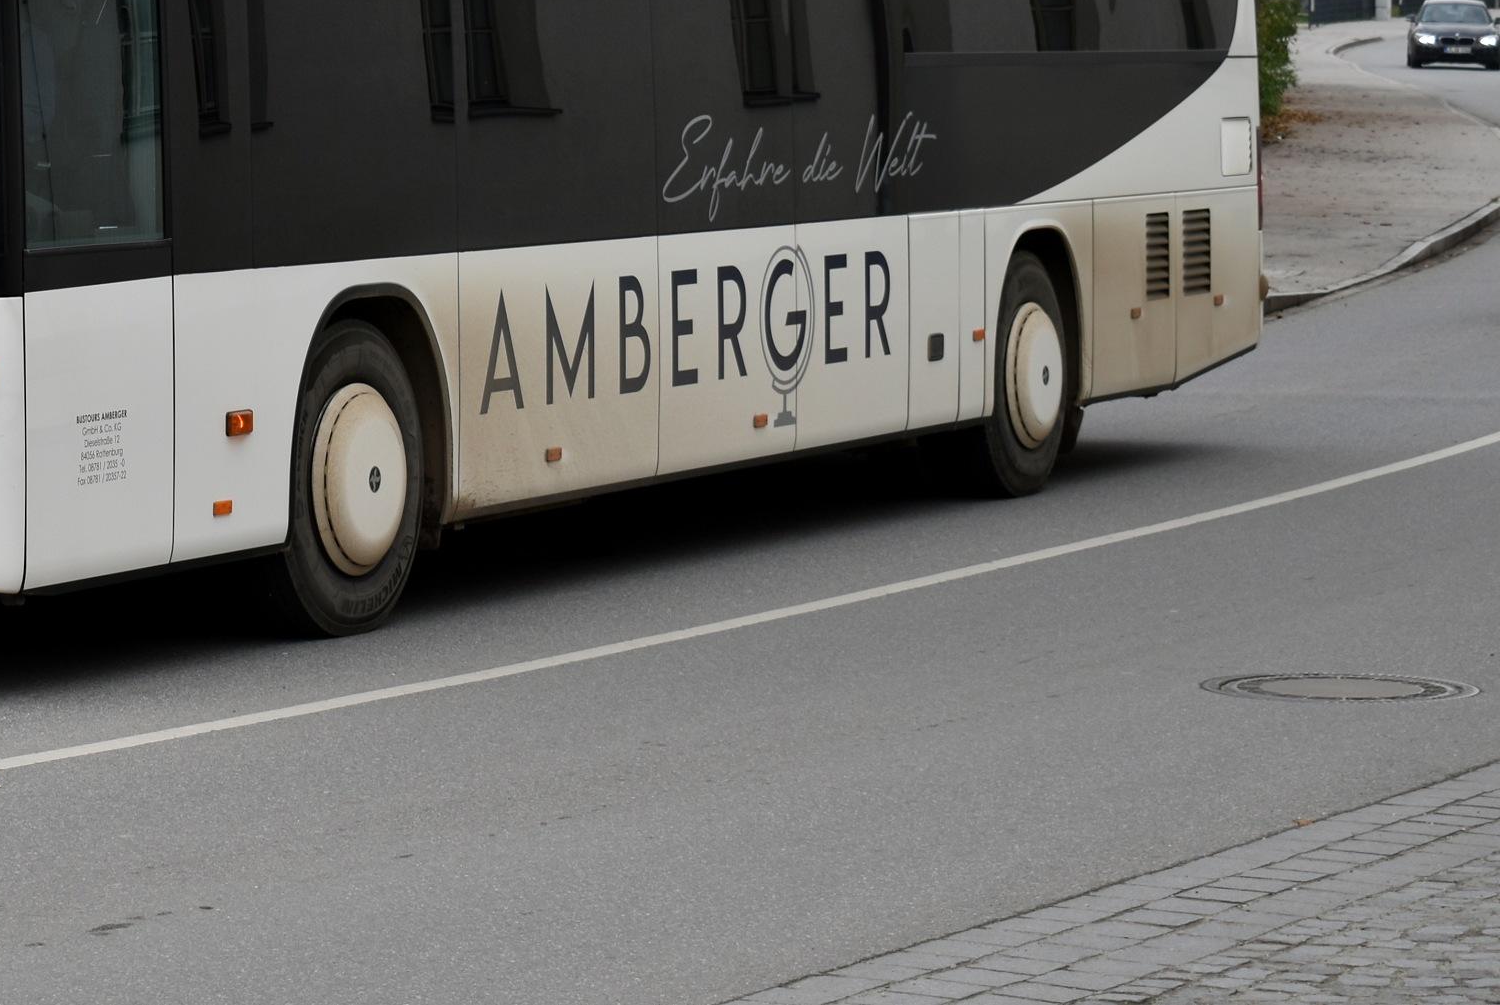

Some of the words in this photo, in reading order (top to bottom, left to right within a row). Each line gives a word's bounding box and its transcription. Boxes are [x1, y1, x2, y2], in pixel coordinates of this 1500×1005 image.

[662, 114, 790, 222] Erfahre
[802, 132, 843, 183] die
[855, 111, 937, 193] Welt
[480, 250, 891, 415] AMBERGER
[76, 412, 100, 424] BUSTOURS
[101, 409, 127, 420] AMBERGER
